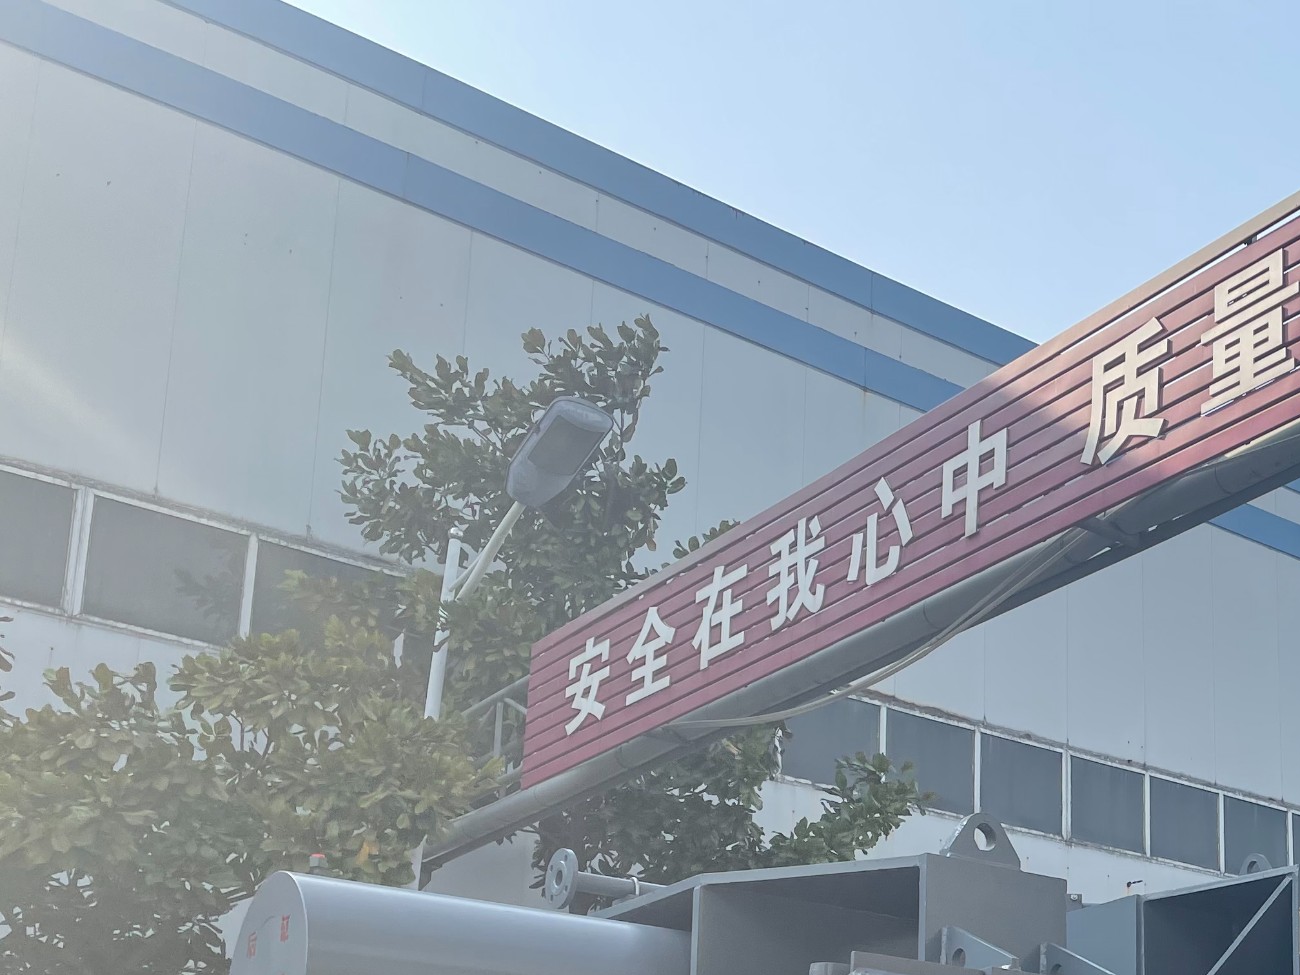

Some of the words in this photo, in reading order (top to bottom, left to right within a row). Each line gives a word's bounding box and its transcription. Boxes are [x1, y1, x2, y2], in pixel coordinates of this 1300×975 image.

[564, 418, 1009, 737] 安全在我心中
